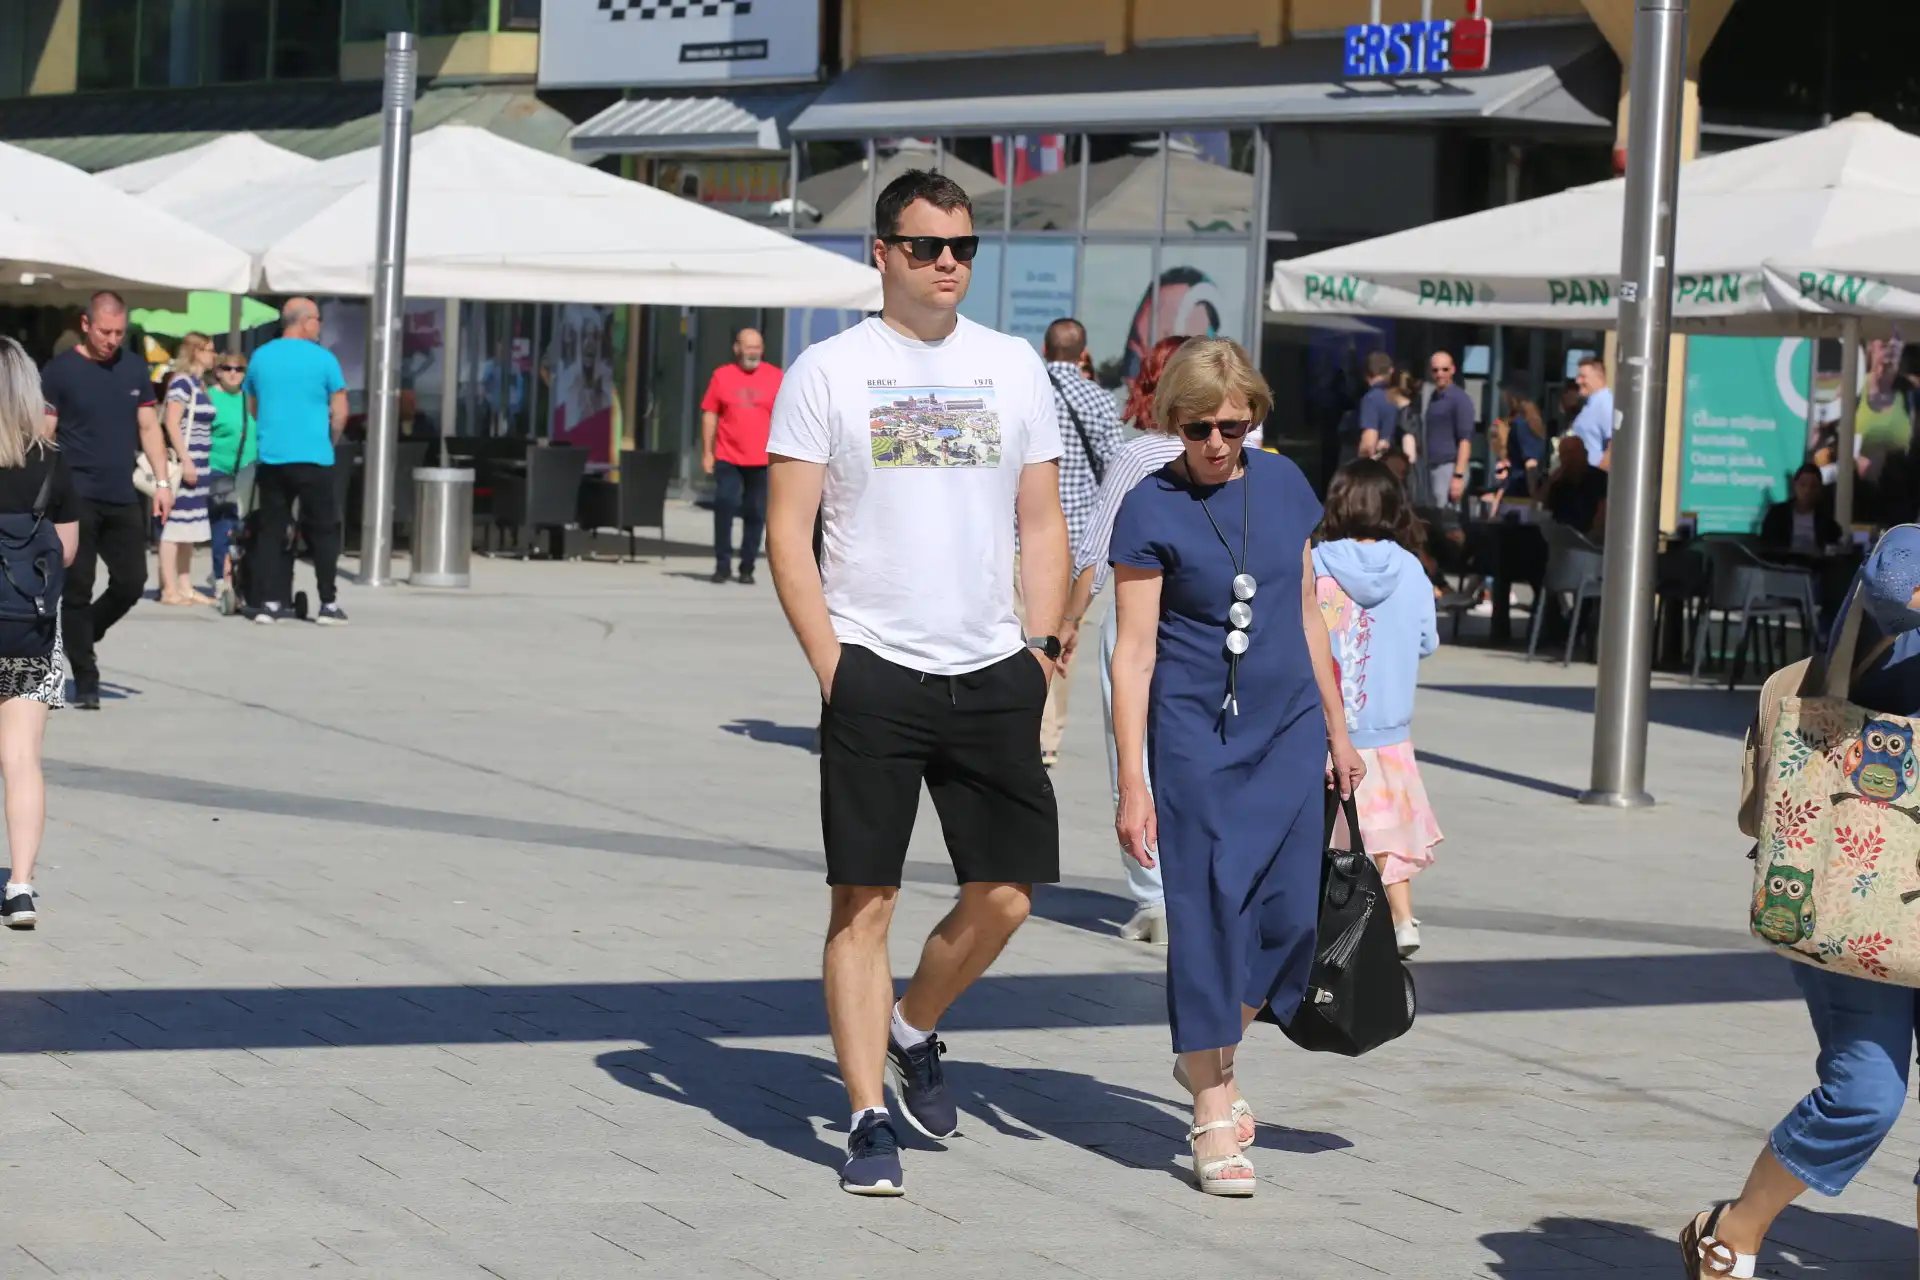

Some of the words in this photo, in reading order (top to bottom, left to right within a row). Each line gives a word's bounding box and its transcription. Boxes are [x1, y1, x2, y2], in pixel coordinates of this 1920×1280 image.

[1343, 20, 1450, 75] ERSTE
[1304, 274, 1360, 301] PAN
[1418, 279, 1474, 306] PAN
[1548, 278, 1609, 306] PAN
[1677, 273, 1740, 303] PAN
[1799, 272, 1867, 304] PAN
